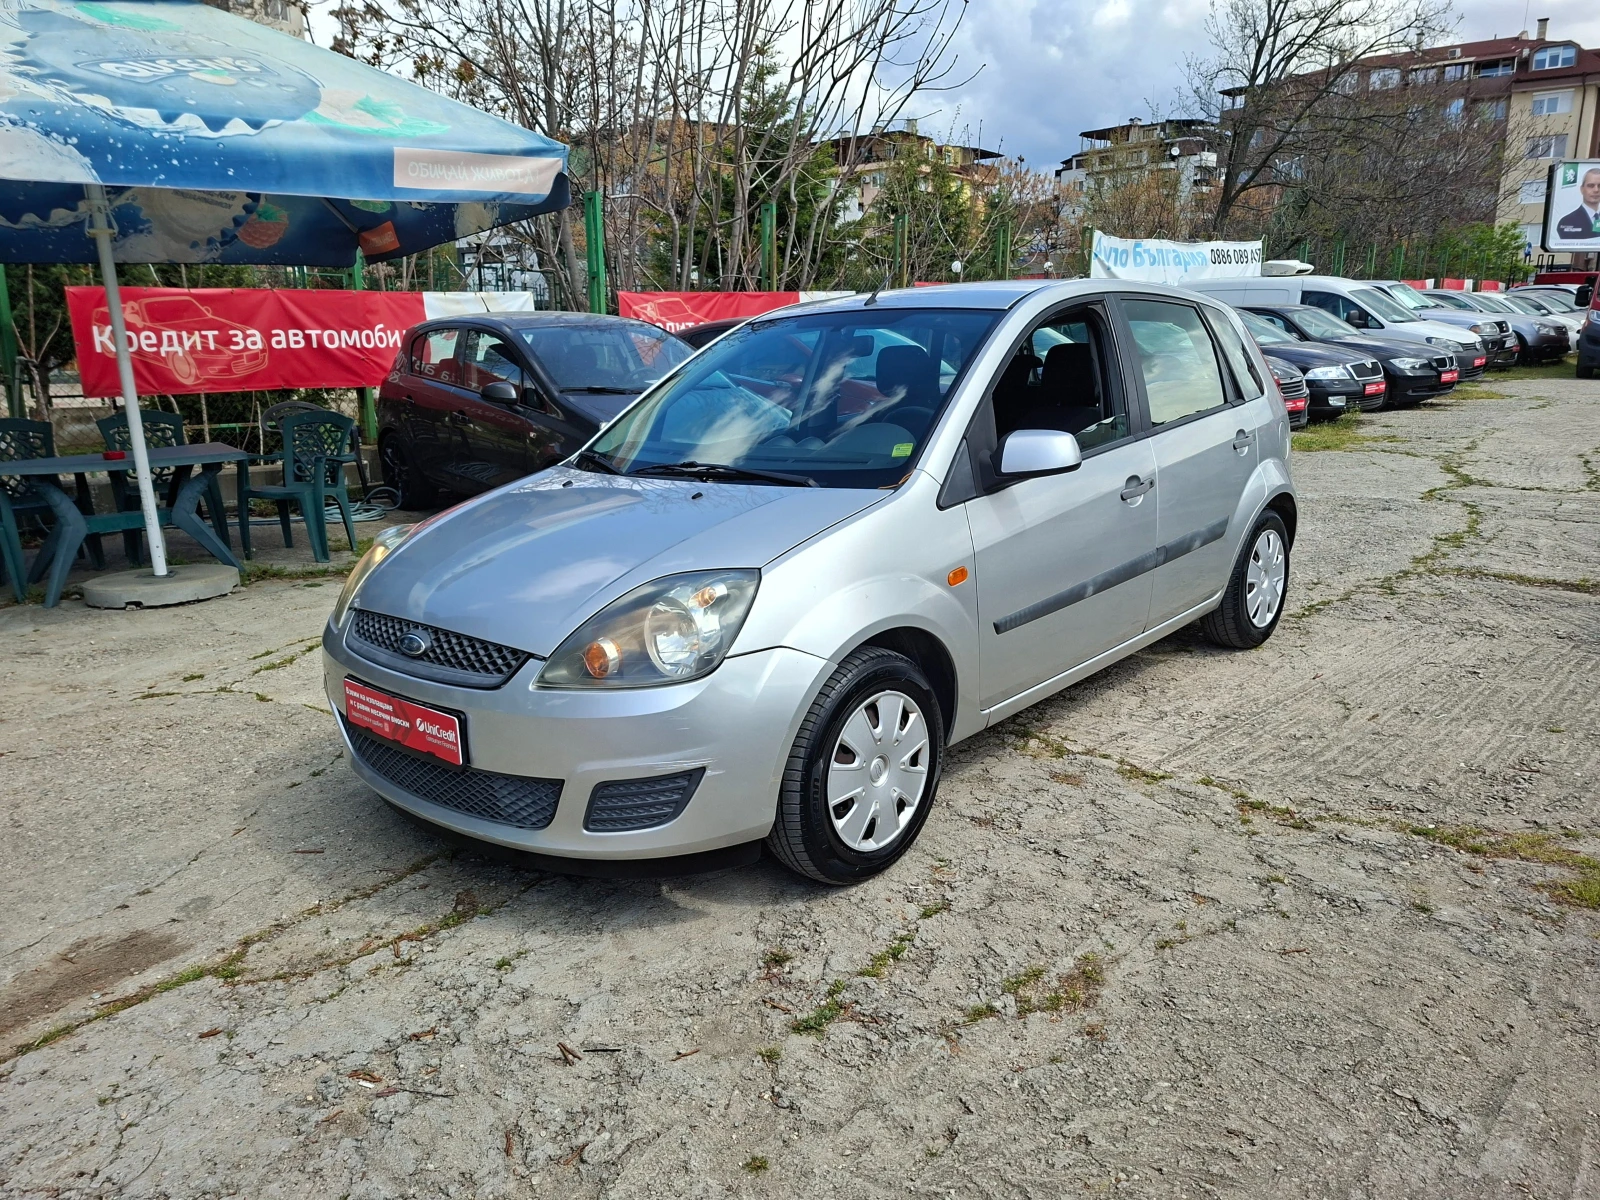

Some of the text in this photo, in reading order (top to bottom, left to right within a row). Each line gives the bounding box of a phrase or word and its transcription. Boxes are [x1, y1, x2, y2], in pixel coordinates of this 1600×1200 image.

[408, 161, 469, 182] ОБИЧАЙ
[1210, 248, 1232, 265] 0886
[1233, 248, 1249, 265] 089
[228, 329, 263, 350] за
[271, 324, 406, 349] автомоби
[424, 721, 456, 744] UniCredit
